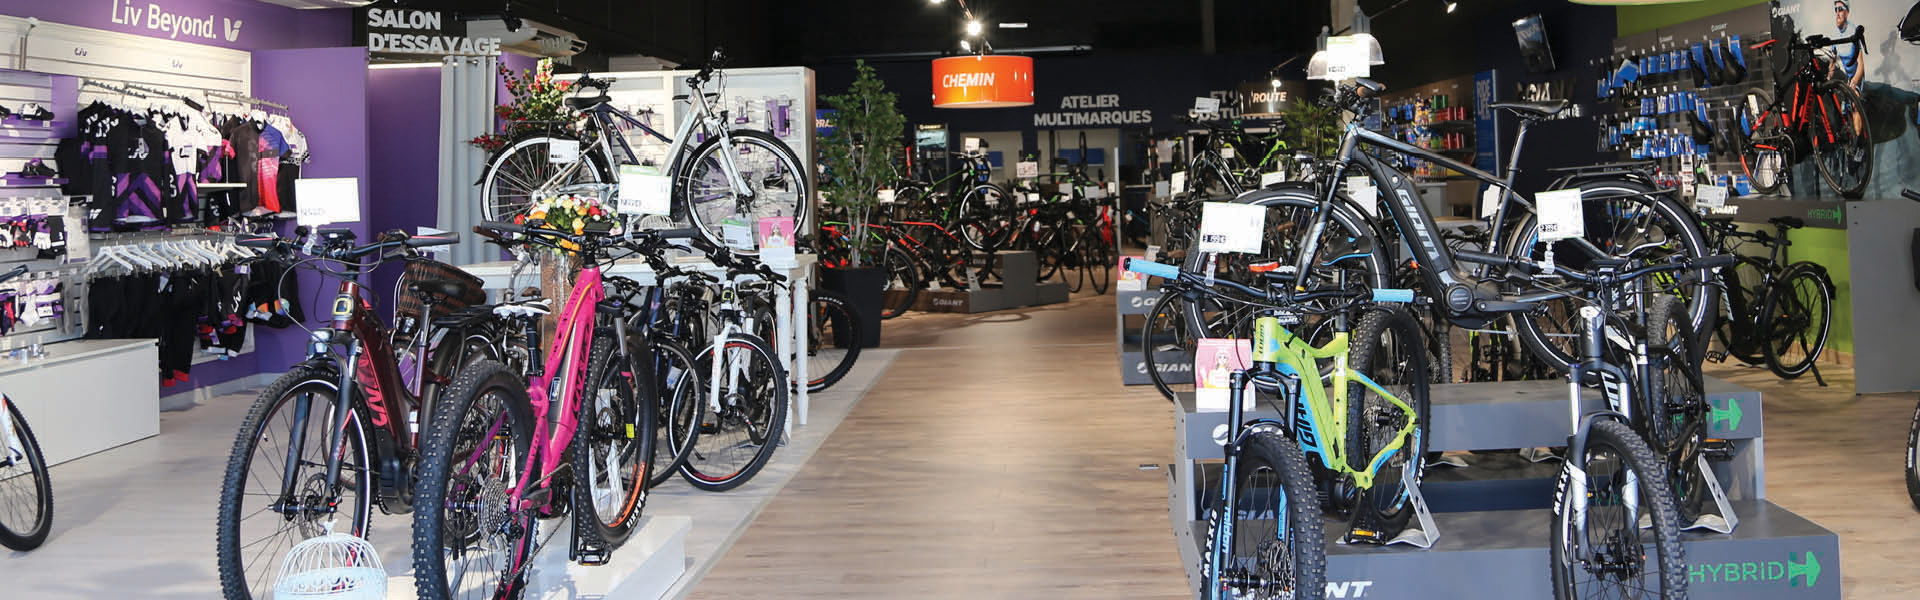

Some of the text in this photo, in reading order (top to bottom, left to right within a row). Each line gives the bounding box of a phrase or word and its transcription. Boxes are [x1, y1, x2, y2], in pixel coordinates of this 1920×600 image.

[112, 0, 217, 39] Liv Beyond.
[368, 8, 441, 30] SALON
[368, 33, 501, 56] D'ESSAYAGE
[943, 72, 995, 88] CHEMIN
[1061, 94, 1119, 109] ATELIER
[1034, 110, 1152, 126] MULTIMARQUES
[1396, 189, 1440, 260] GIANT
[1807, 208, 1833, 220] HYBRID
[1154, 362, 1194, 373] GIAN
[626, 490, 645, 529] MAXXIS
[1203, 508, 1218, 578] MAXXIS
[1688, 560, 1785, 583] HYBRID
